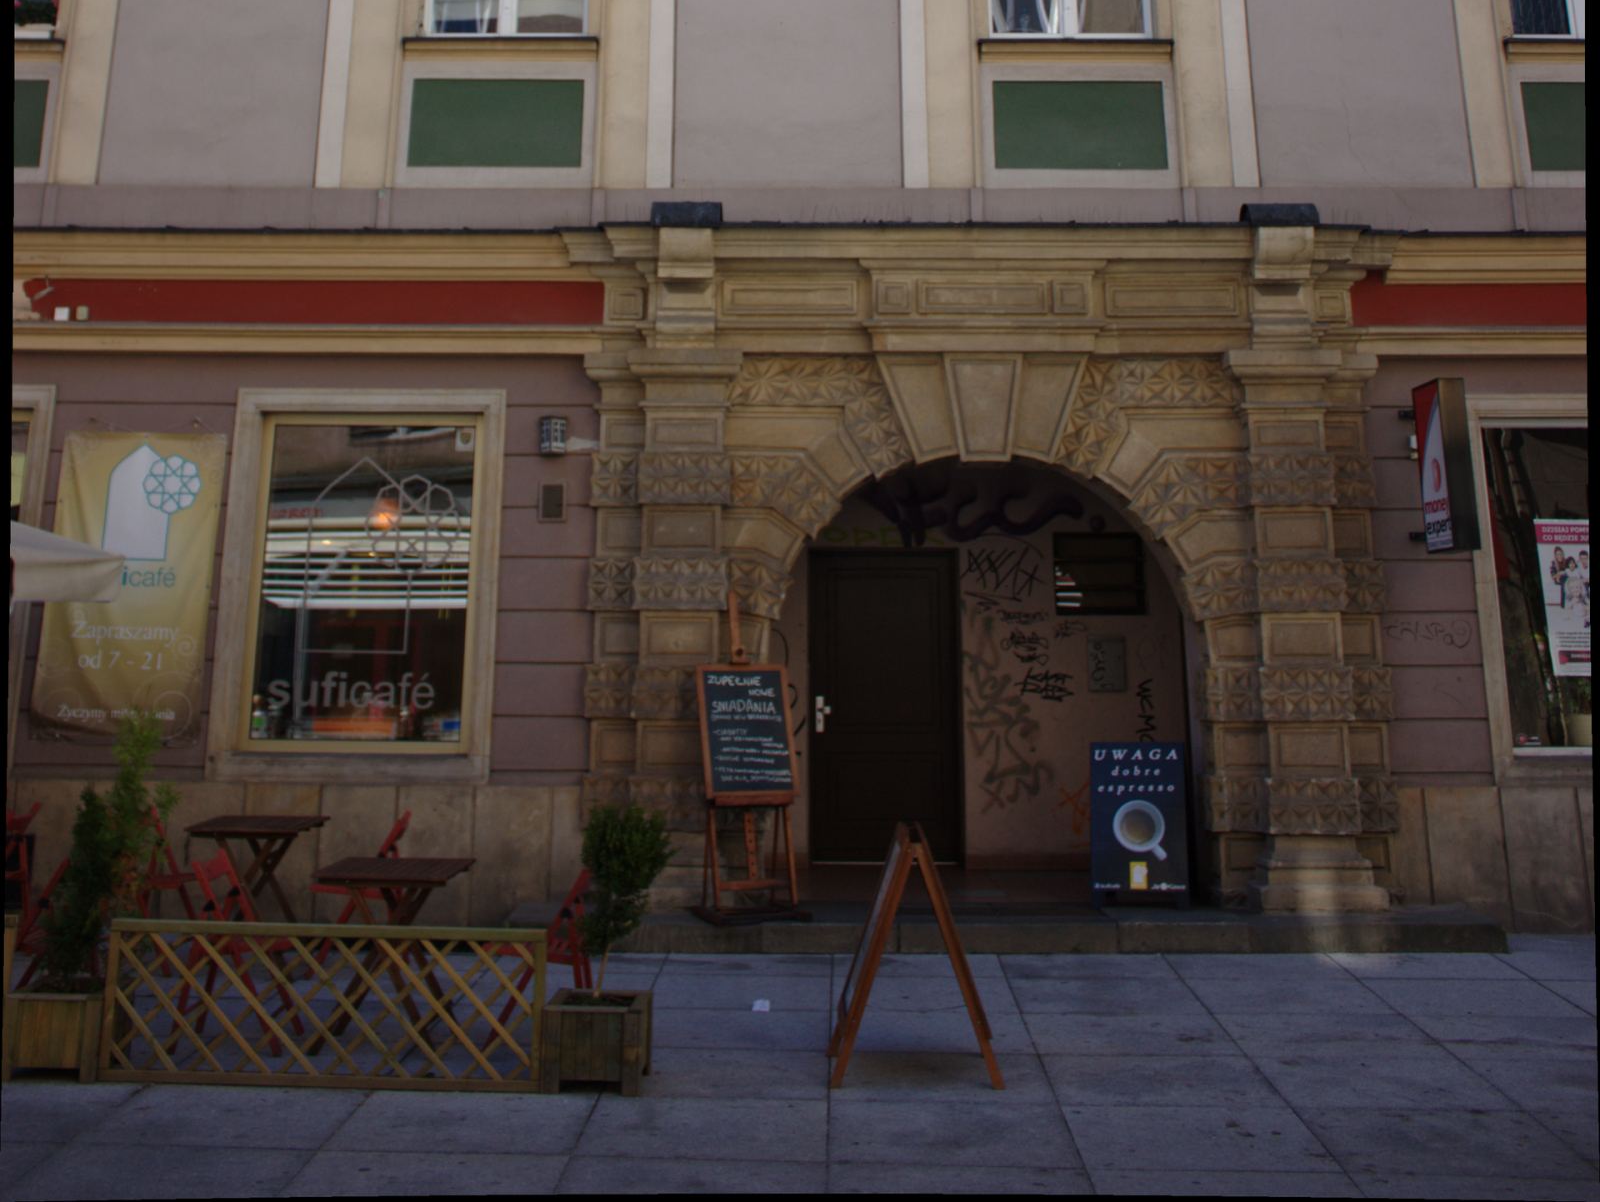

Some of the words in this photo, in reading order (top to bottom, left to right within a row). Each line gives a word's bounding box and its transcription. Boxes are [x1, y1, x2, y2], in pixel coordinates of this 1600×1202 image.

[1426, 518, 1453, 539] expert
[121, 566, 175, 588] icafé
[72, 621, 178, 647] Zapraszamy
[78, 651, 101, 670] od
[108, 651, 120, 669] 7
[140, 652, 162, 671] 21
[267, 672, 435, 709] suficafé
[1094, 749, 1178, 761] UWAGA
[1111, 765, 1161, 777] dobre
[1097, 783, 1175, 796] espresso
